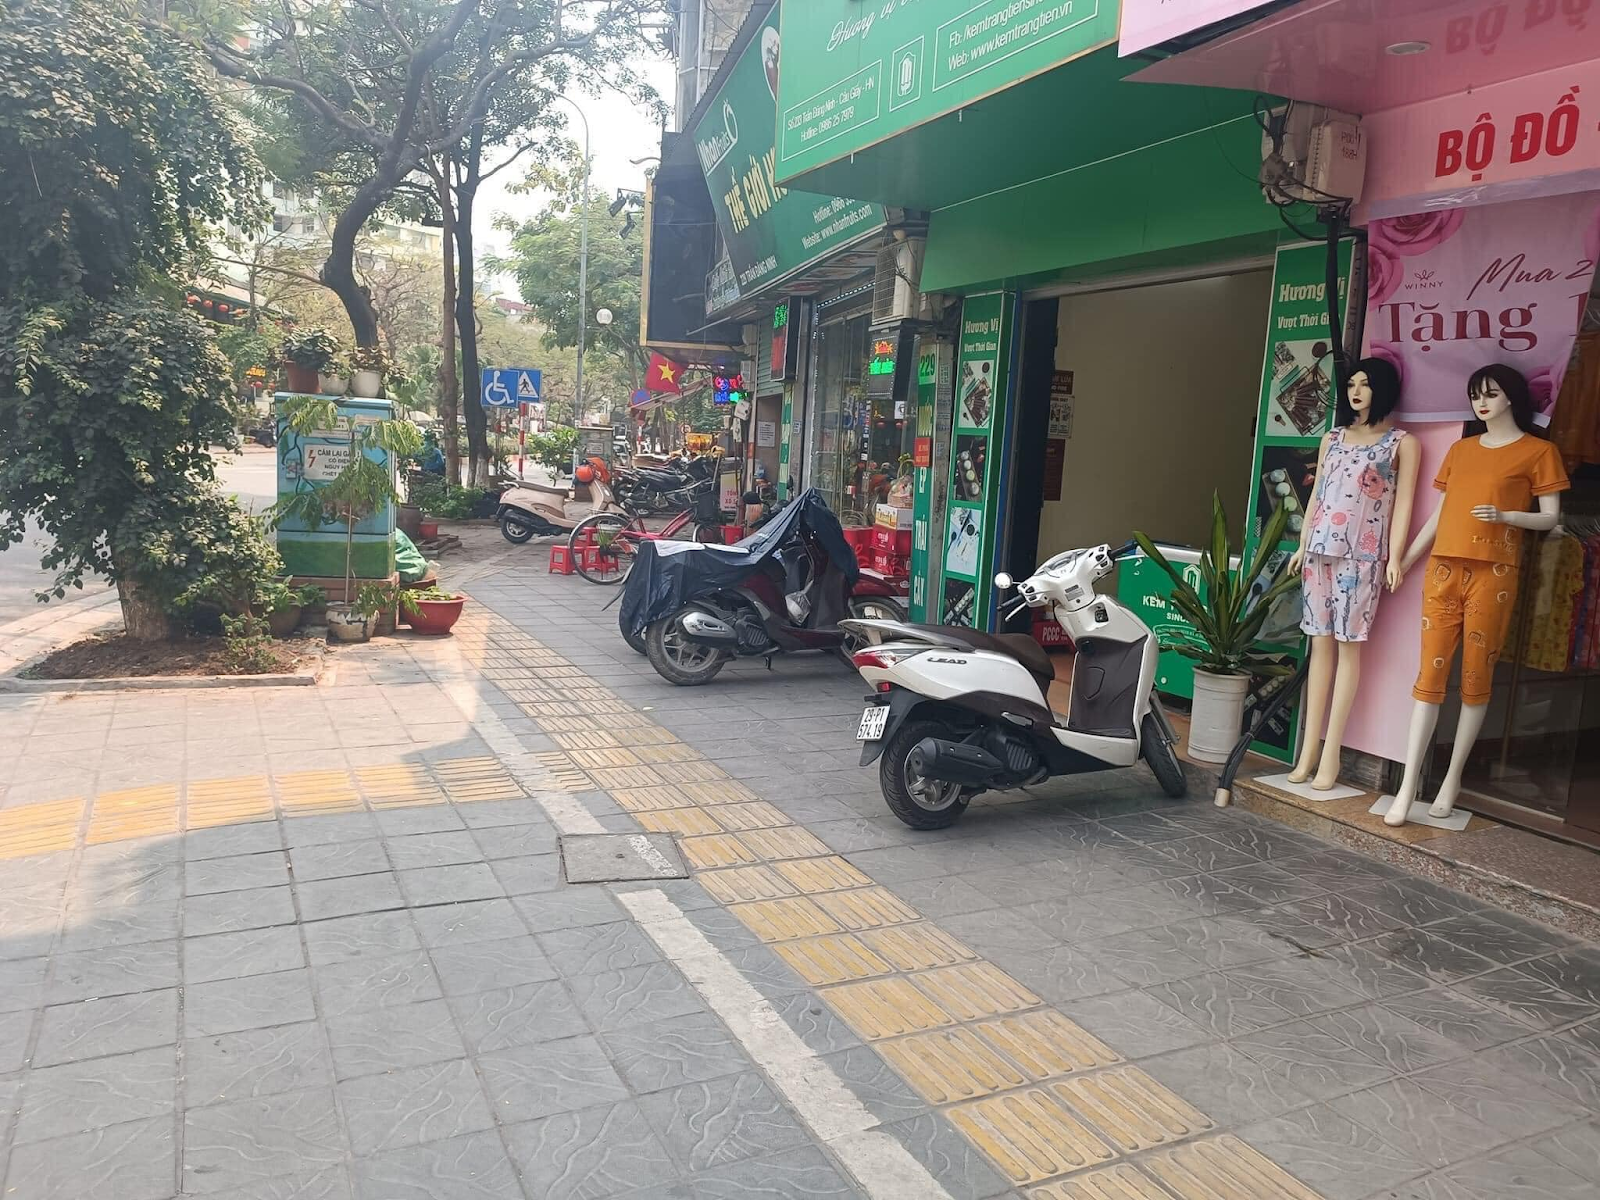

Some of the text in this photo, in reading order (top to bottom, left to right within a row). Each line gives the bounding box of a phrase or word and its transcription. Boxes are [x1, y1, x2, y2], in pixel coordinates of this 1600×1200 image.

[947, 1, 1073, 71] Web: www.kemtrangtien.vn
[948, 31, 962, 49] Fb:
[865, 75, 875, 92] HN
[1435, 85, 1580, 182] BỘ ĐỒ
[724, 166, 750, 234] THẾ
[742, 154, 772, 220] GIỚI
[1404, 281, 1444, 290] WINNY
[1466, 253, 1594, 300] Mua 2
[1278, 283, 1326, 303] Hương
[965, 317, 999, 335] Hương Vị
[1277, 315, 1297, 331] Vượt
[1299, 312, 1319, 328] Thời
[1378, 302, 1538, 352] Tặng
[919, 352, 935, 378] 229
[1042, 626, 1060, 642] PCCC
[926, 656, 968, 666] LEAD
